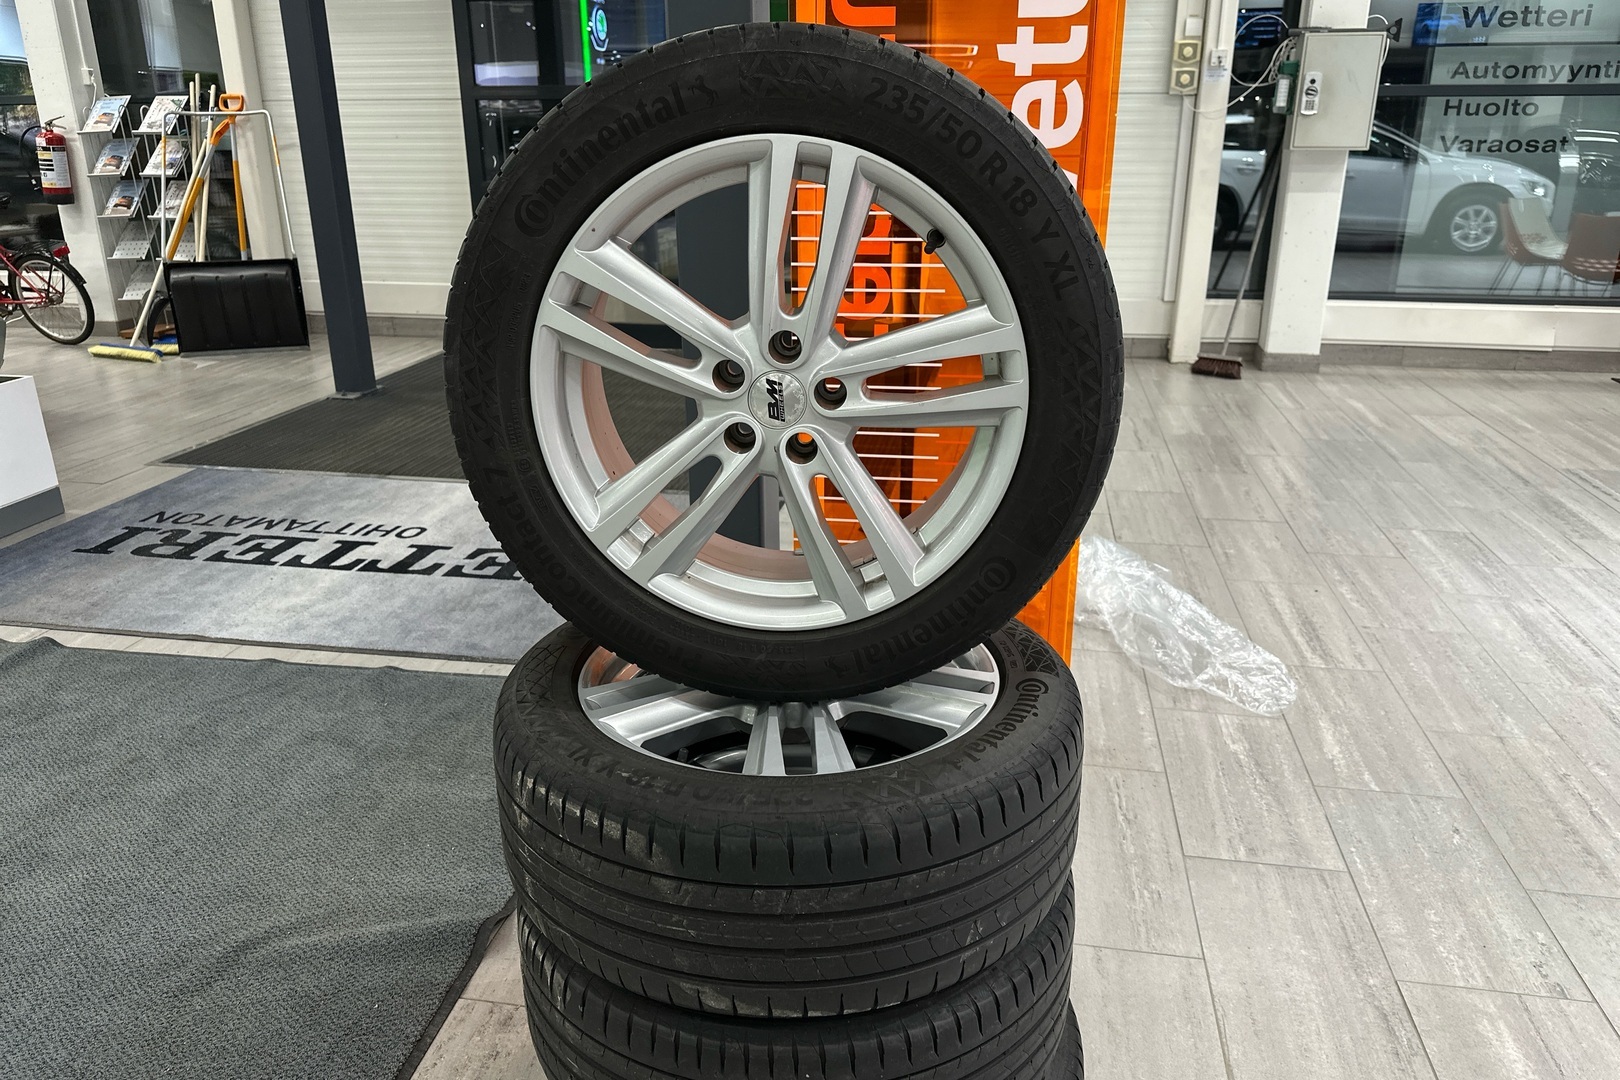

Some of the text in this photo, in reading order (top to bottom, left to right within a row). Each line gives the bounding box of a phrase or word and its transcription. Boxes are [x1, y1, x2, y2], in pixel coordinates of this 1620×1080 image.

[1462, 4, 1594, 28] Wetteri
[1450, 60, 1620, 83] Automyynti
[997, 0, 1090, 191] et
[1443, 99, 1539, 117] Huolto
[864, 76, 983, 160] 235/50
[513, 82, 689, 238] Continental
[1440, 135, 1568, 154] Varaosat
[977, 150, 1010, 185] R
[1000, 175, 1039, 218] 18
[1030, 216, 1061, 246] Y
[1043, 252, 1080, 300] XL
[766, 378, 780, 421] BM
[139, 510, 427, 539] OHITTAMATON
[72, 525, 524, 581] ETTERI
[851, 555, 1018, 677] Continental
[963, 678, 1049, 763] Continental
